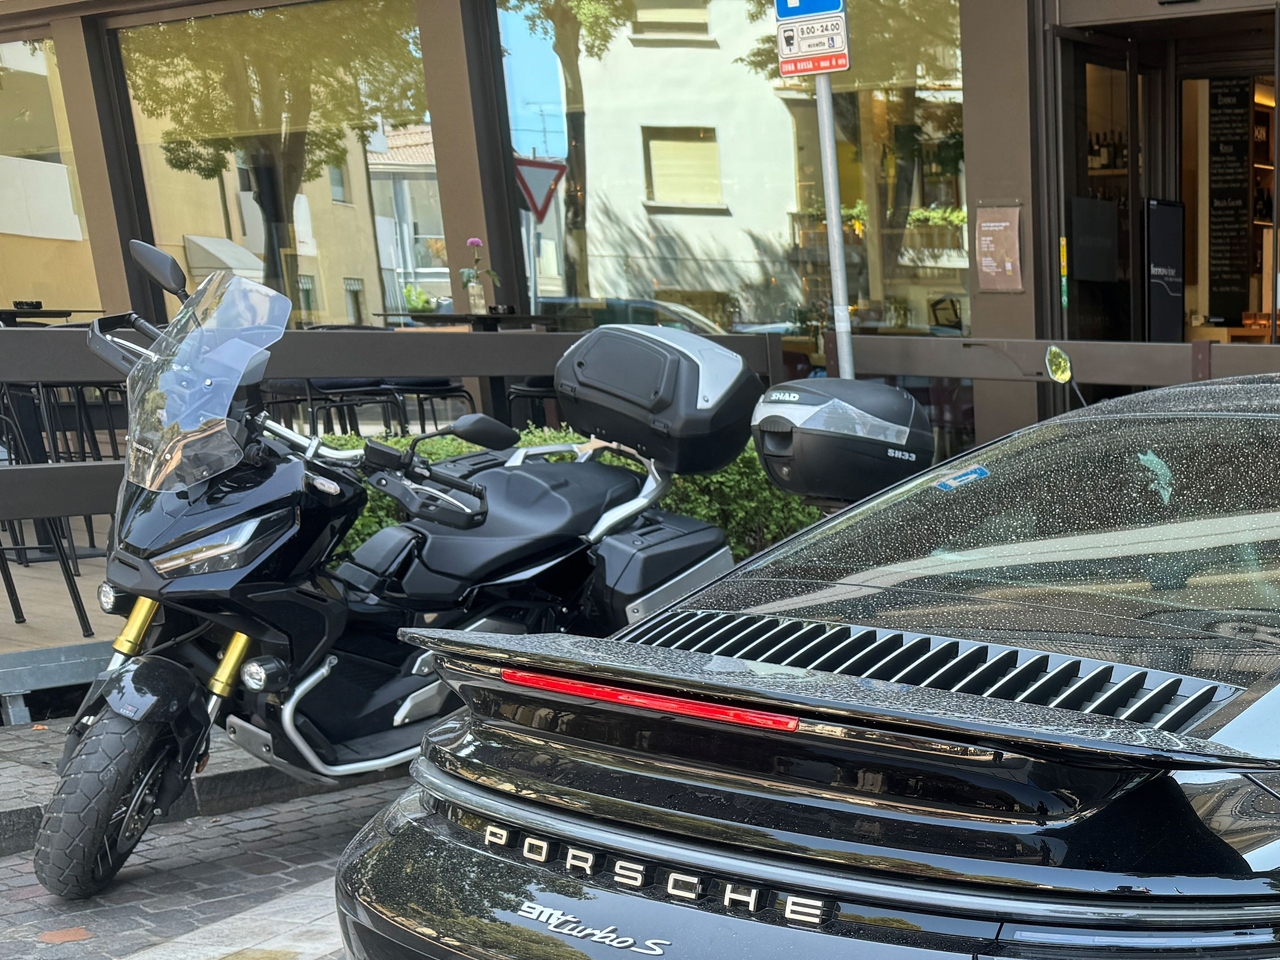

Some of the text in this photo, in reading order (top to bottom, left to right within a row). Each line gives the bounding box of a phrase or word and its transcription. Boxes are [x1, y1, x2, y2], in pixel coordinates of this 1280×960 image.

[808, 41, 826, 49] eccetto
[770, 392, 800, 402] SHAD
[887, 448, 917, 462] SH33
[484, 824, 825, 924] PORSCHE
[631, 939, 673, 957] S
